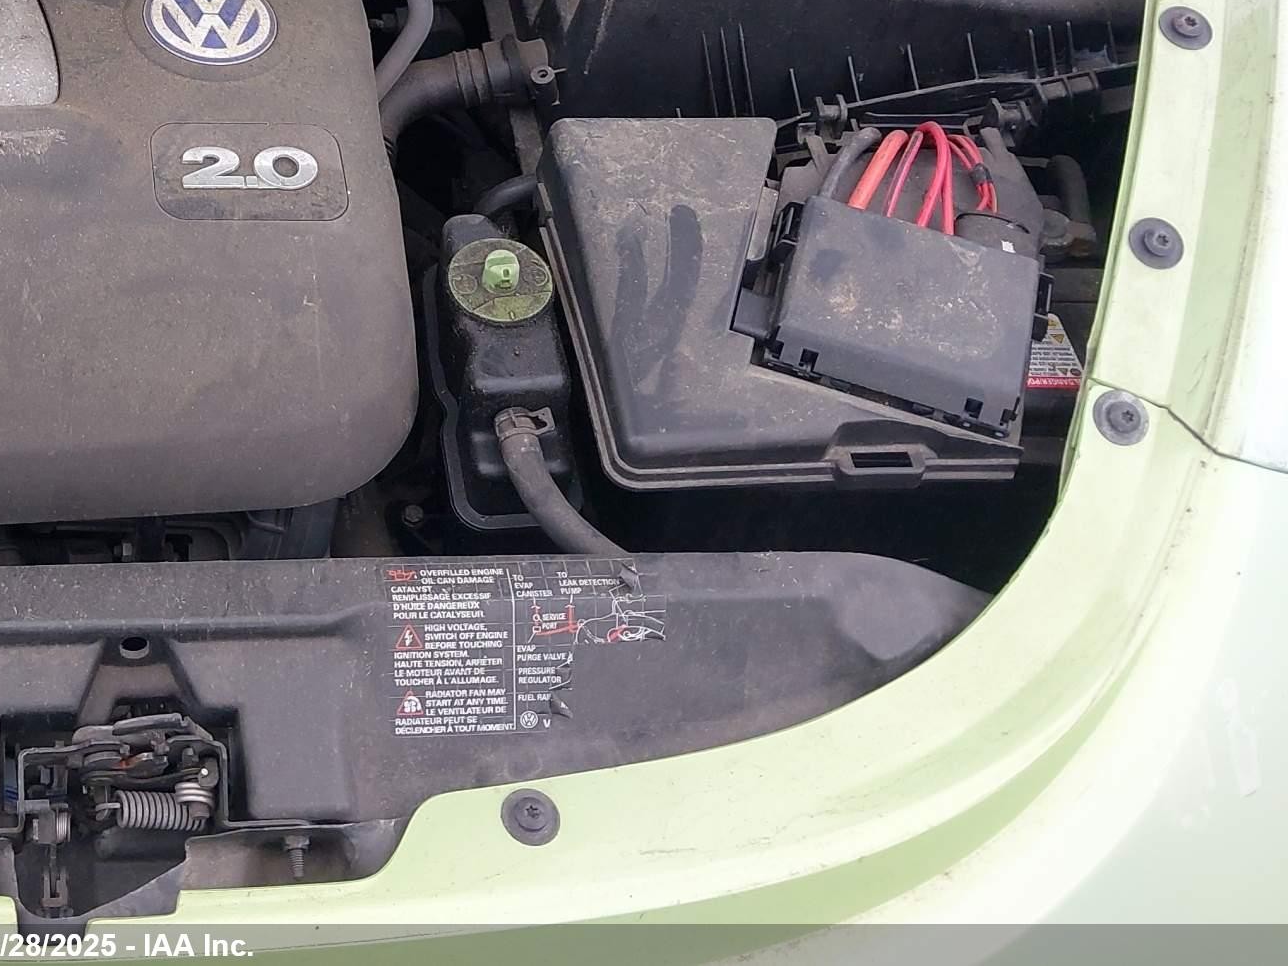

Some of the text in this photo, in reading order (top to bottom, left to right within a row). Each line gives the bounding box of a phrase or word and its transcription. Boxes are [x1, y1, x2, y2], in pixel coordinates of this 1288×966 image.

[181, 146, 319, 190] 2.0
[419, 568, 505, 577] OVERFILLED ENGINE
[421, 577, 436, 585] OIL
[457, 576, 496, 584] DAMAGE
[559, 579, 578, 587] LEAK
[392, 593, 451, 601] REMPLISSAGE
[516, 589, 553, 597] CANISTER
[427, 601, 480, 610] DANGEREUX
[393, 611, 417, 620] POUR
[418, 611, 429, 619] LE
[542, 613, 567, 621] SERVICE
[424, 623, 446, 632] HIGH
[542, 622, 558, 630] PORT
[424, 632, 458, 641] SWITCH
[476, 631, 509, 639] ENGINE
[424, 640, 503, 650] BEFORE TOUCHING
[517, 644, 536, 653] EVAP
[393, 651, 432, 660] IGNITION
[517, 652, 567, 661] PURGE VALVE
[393, 660, 423, 668] HAUTE
[394, 667, 485, 677] LE MOTEUR AVANT DE
[518, 666, 556, 675] PRESSURE
[393, 678, 434, 686] TOUCHER
[518, 675, 562, 684] REGULATOR
[425, 688, 506, 698] RADIATOR FAN MAY
[517, 693, 536, 701] FUEL
[425, 699, 452, 707] START
[453, 698, 465, 706] AT
[466, 697, 485, 705] ANY
[425, 705, 507, 716] LE VENTILATEUR DE
[394, 715, 478, 726] RADIATEUR PEUT SE
[454, 724, 477, 732] TOUT
